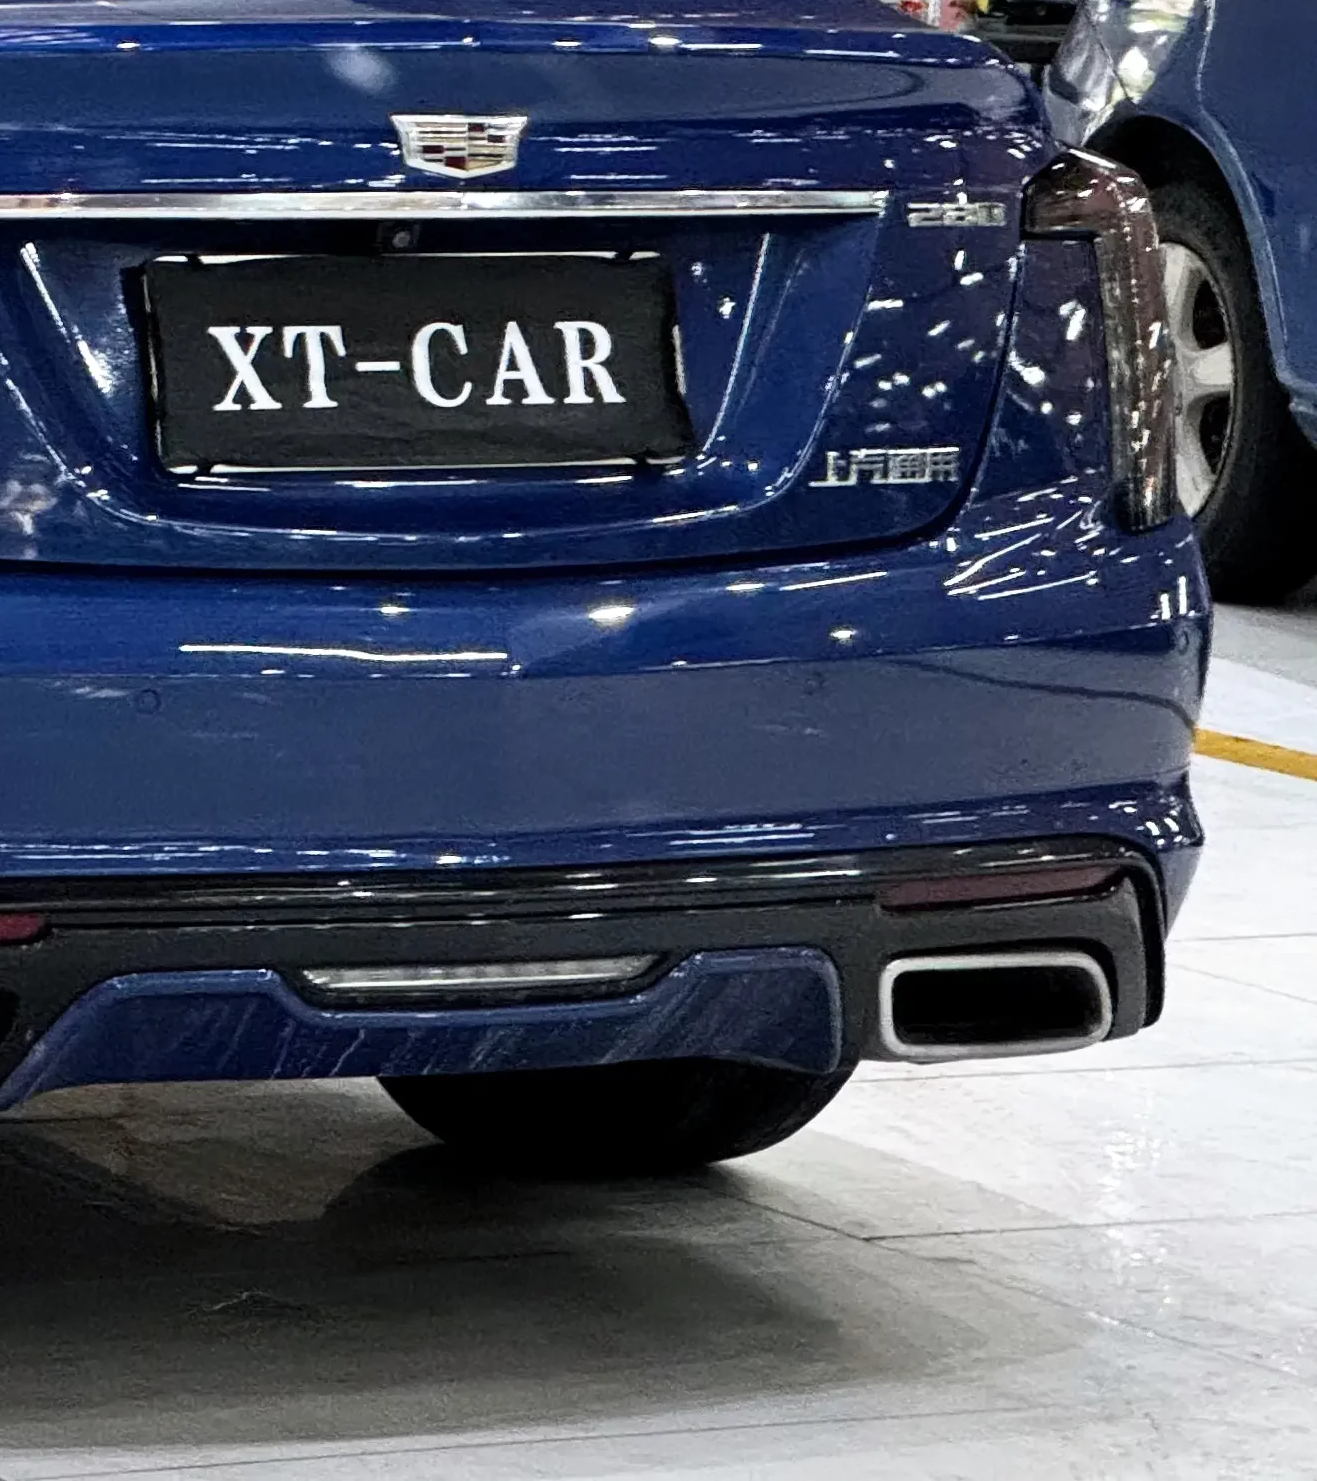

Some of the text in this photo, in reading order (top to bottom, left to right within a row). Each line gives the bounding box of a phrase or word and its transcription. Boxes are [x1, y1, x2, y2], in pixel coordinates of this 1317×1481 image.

[206, 320, 627, 411] XT-CAR
[808, 447, 960, 487] 上汽通用
